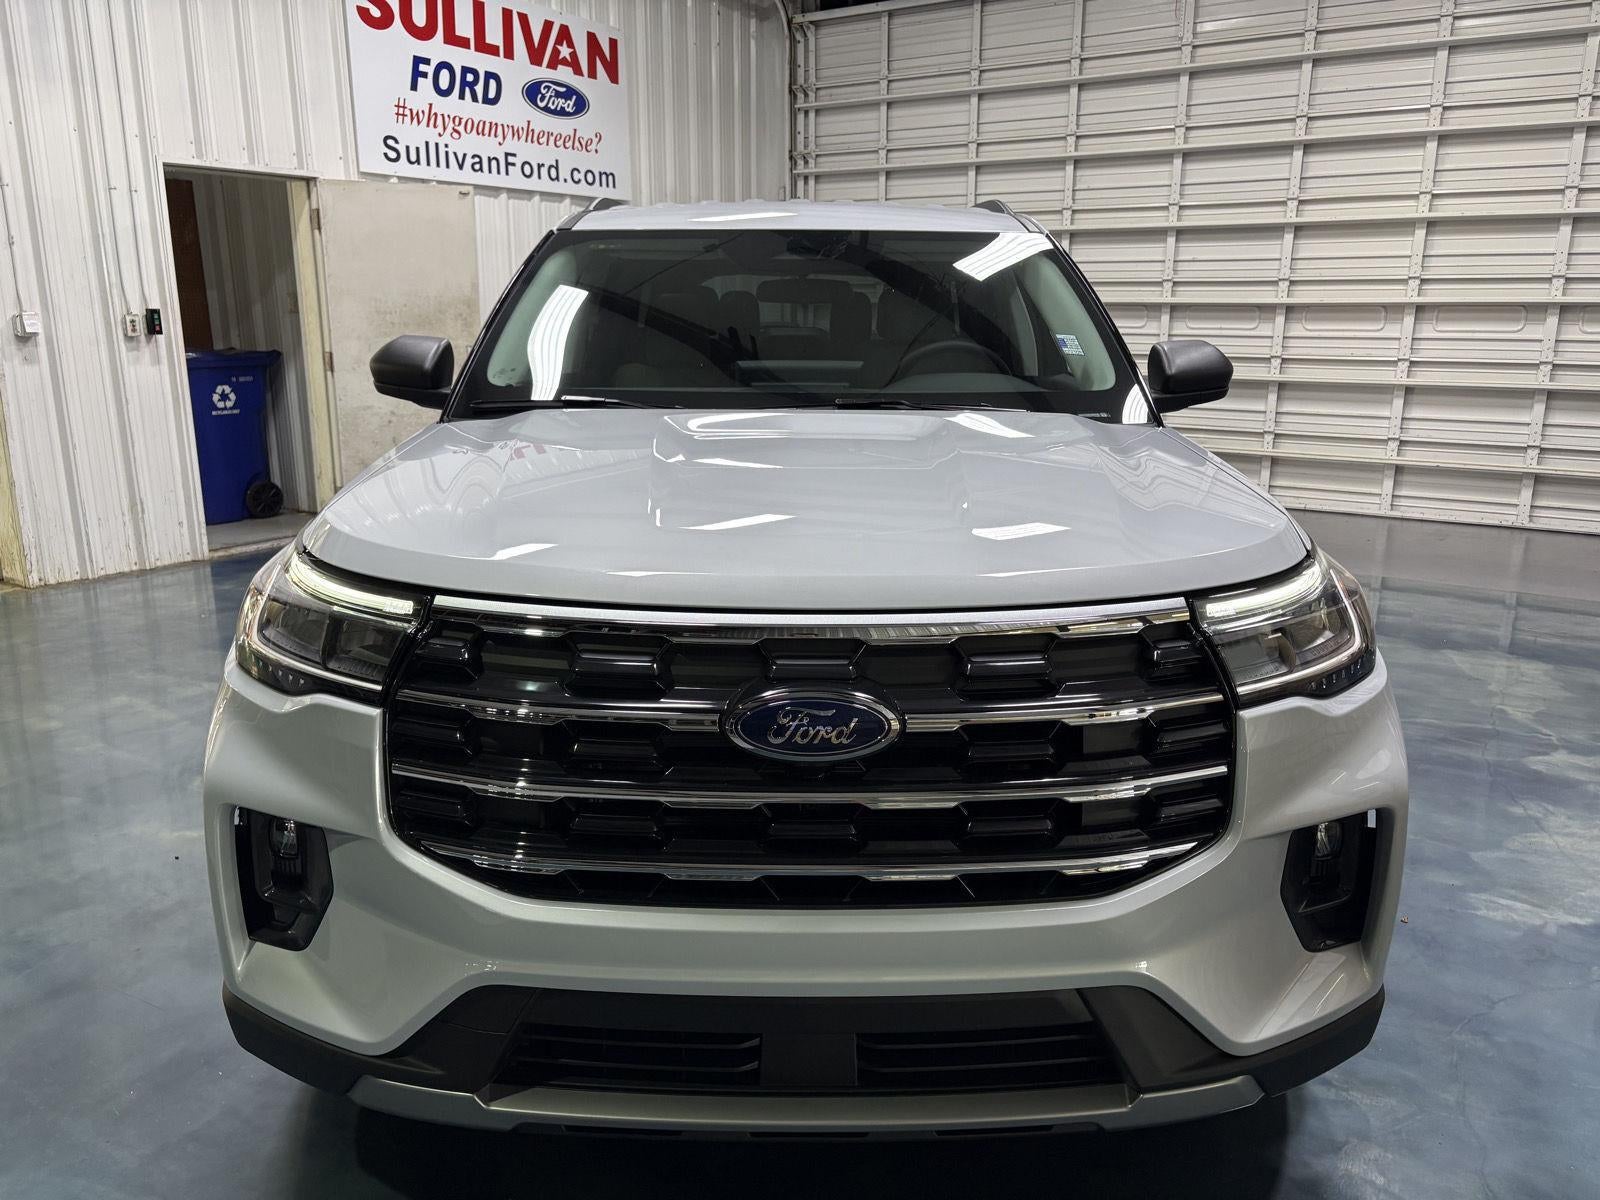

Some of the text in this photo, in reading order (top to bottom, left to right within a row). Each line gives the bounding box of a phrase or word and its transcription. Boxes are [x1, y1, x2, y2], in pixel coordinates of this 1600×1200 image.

[356, 0, 619, 85] SULLIVAN
[409, 54, 503, 106] FORD
[536, 82, 576, 113] Ford
[394, 97, 602, 154] #whygoanywhereelse?
[383, 135, 616, 189] SullivanFord.com
[766, 706, 859, 744] Ford
